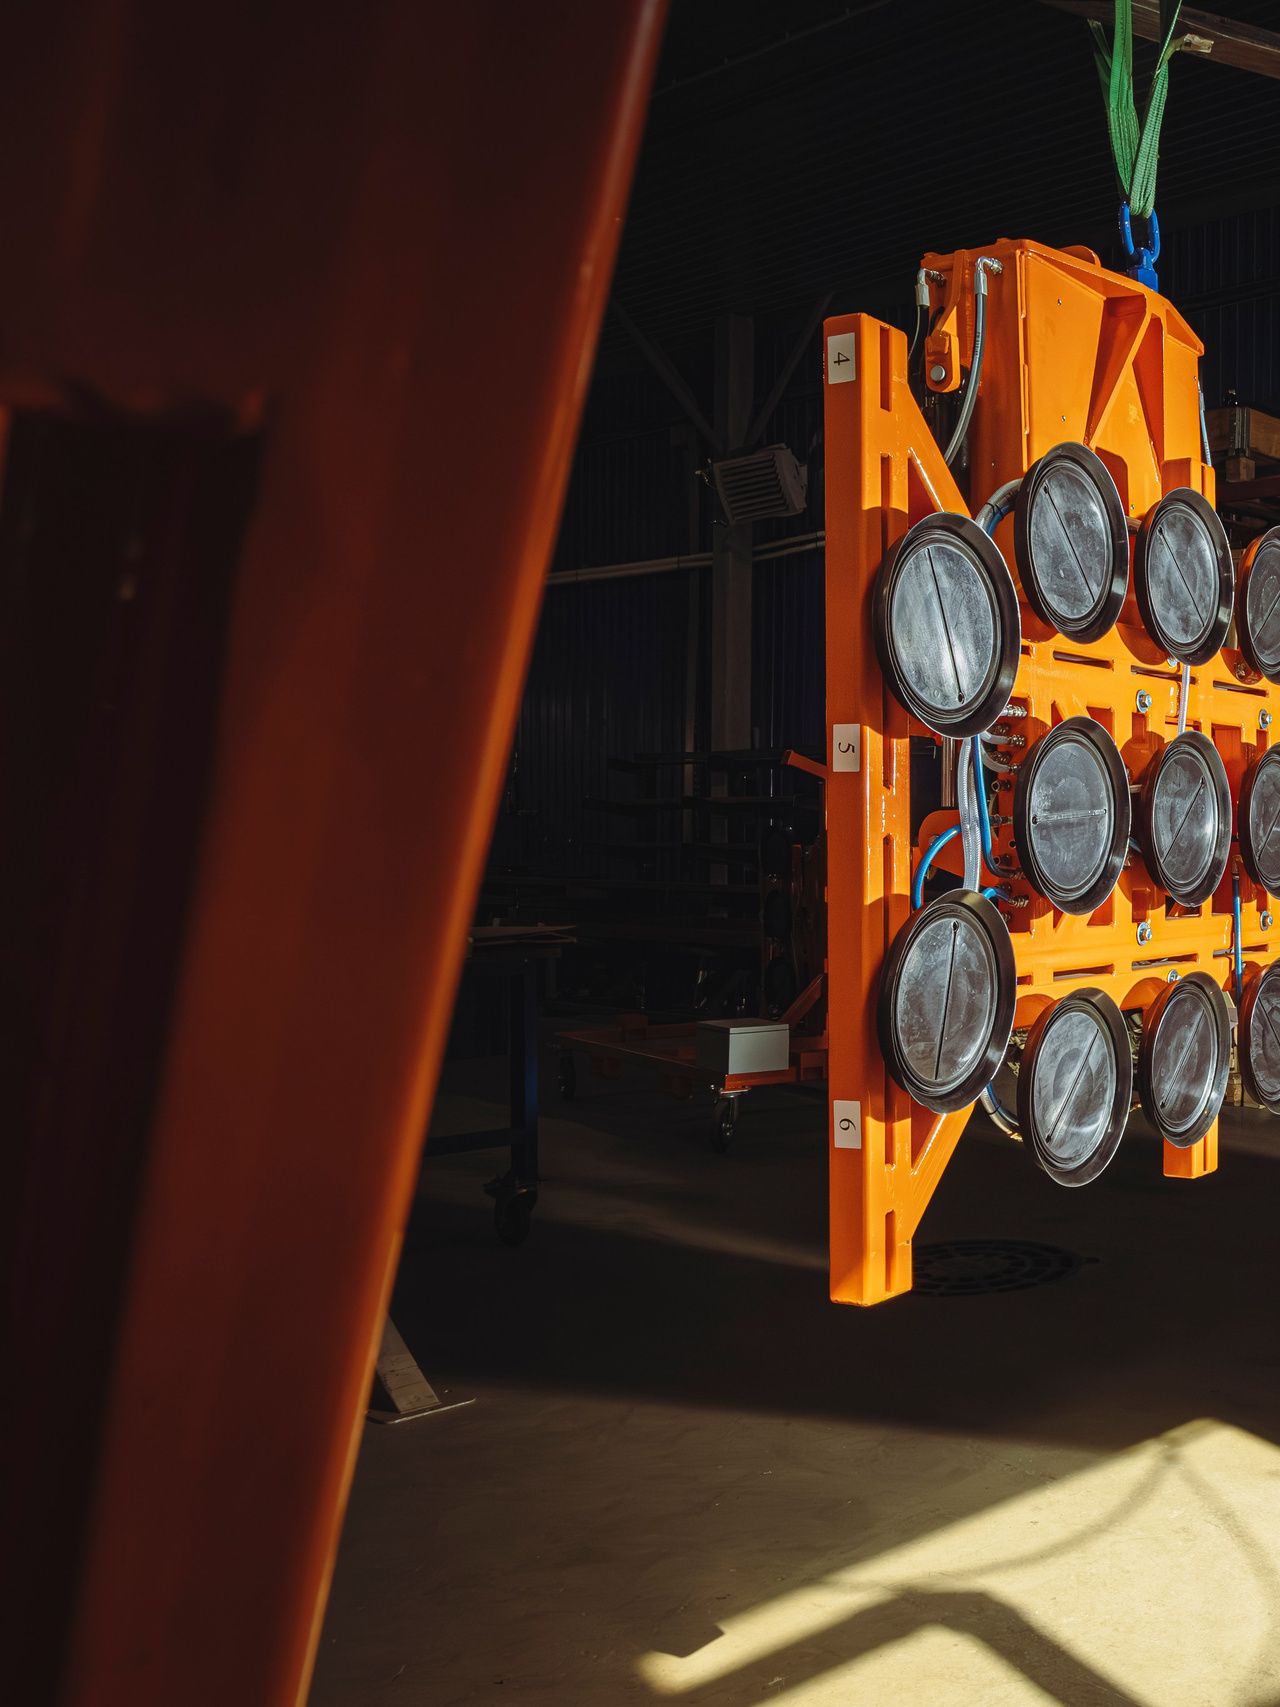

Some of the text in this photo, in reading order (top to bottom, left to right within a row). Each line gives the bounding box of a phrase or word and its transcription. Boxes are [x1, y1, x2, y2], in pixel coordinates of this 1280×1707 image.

[833, 351, 850, 365] 4
[838, 742, 855, 754] 5
[839, 1118, 857, 1131] 6
